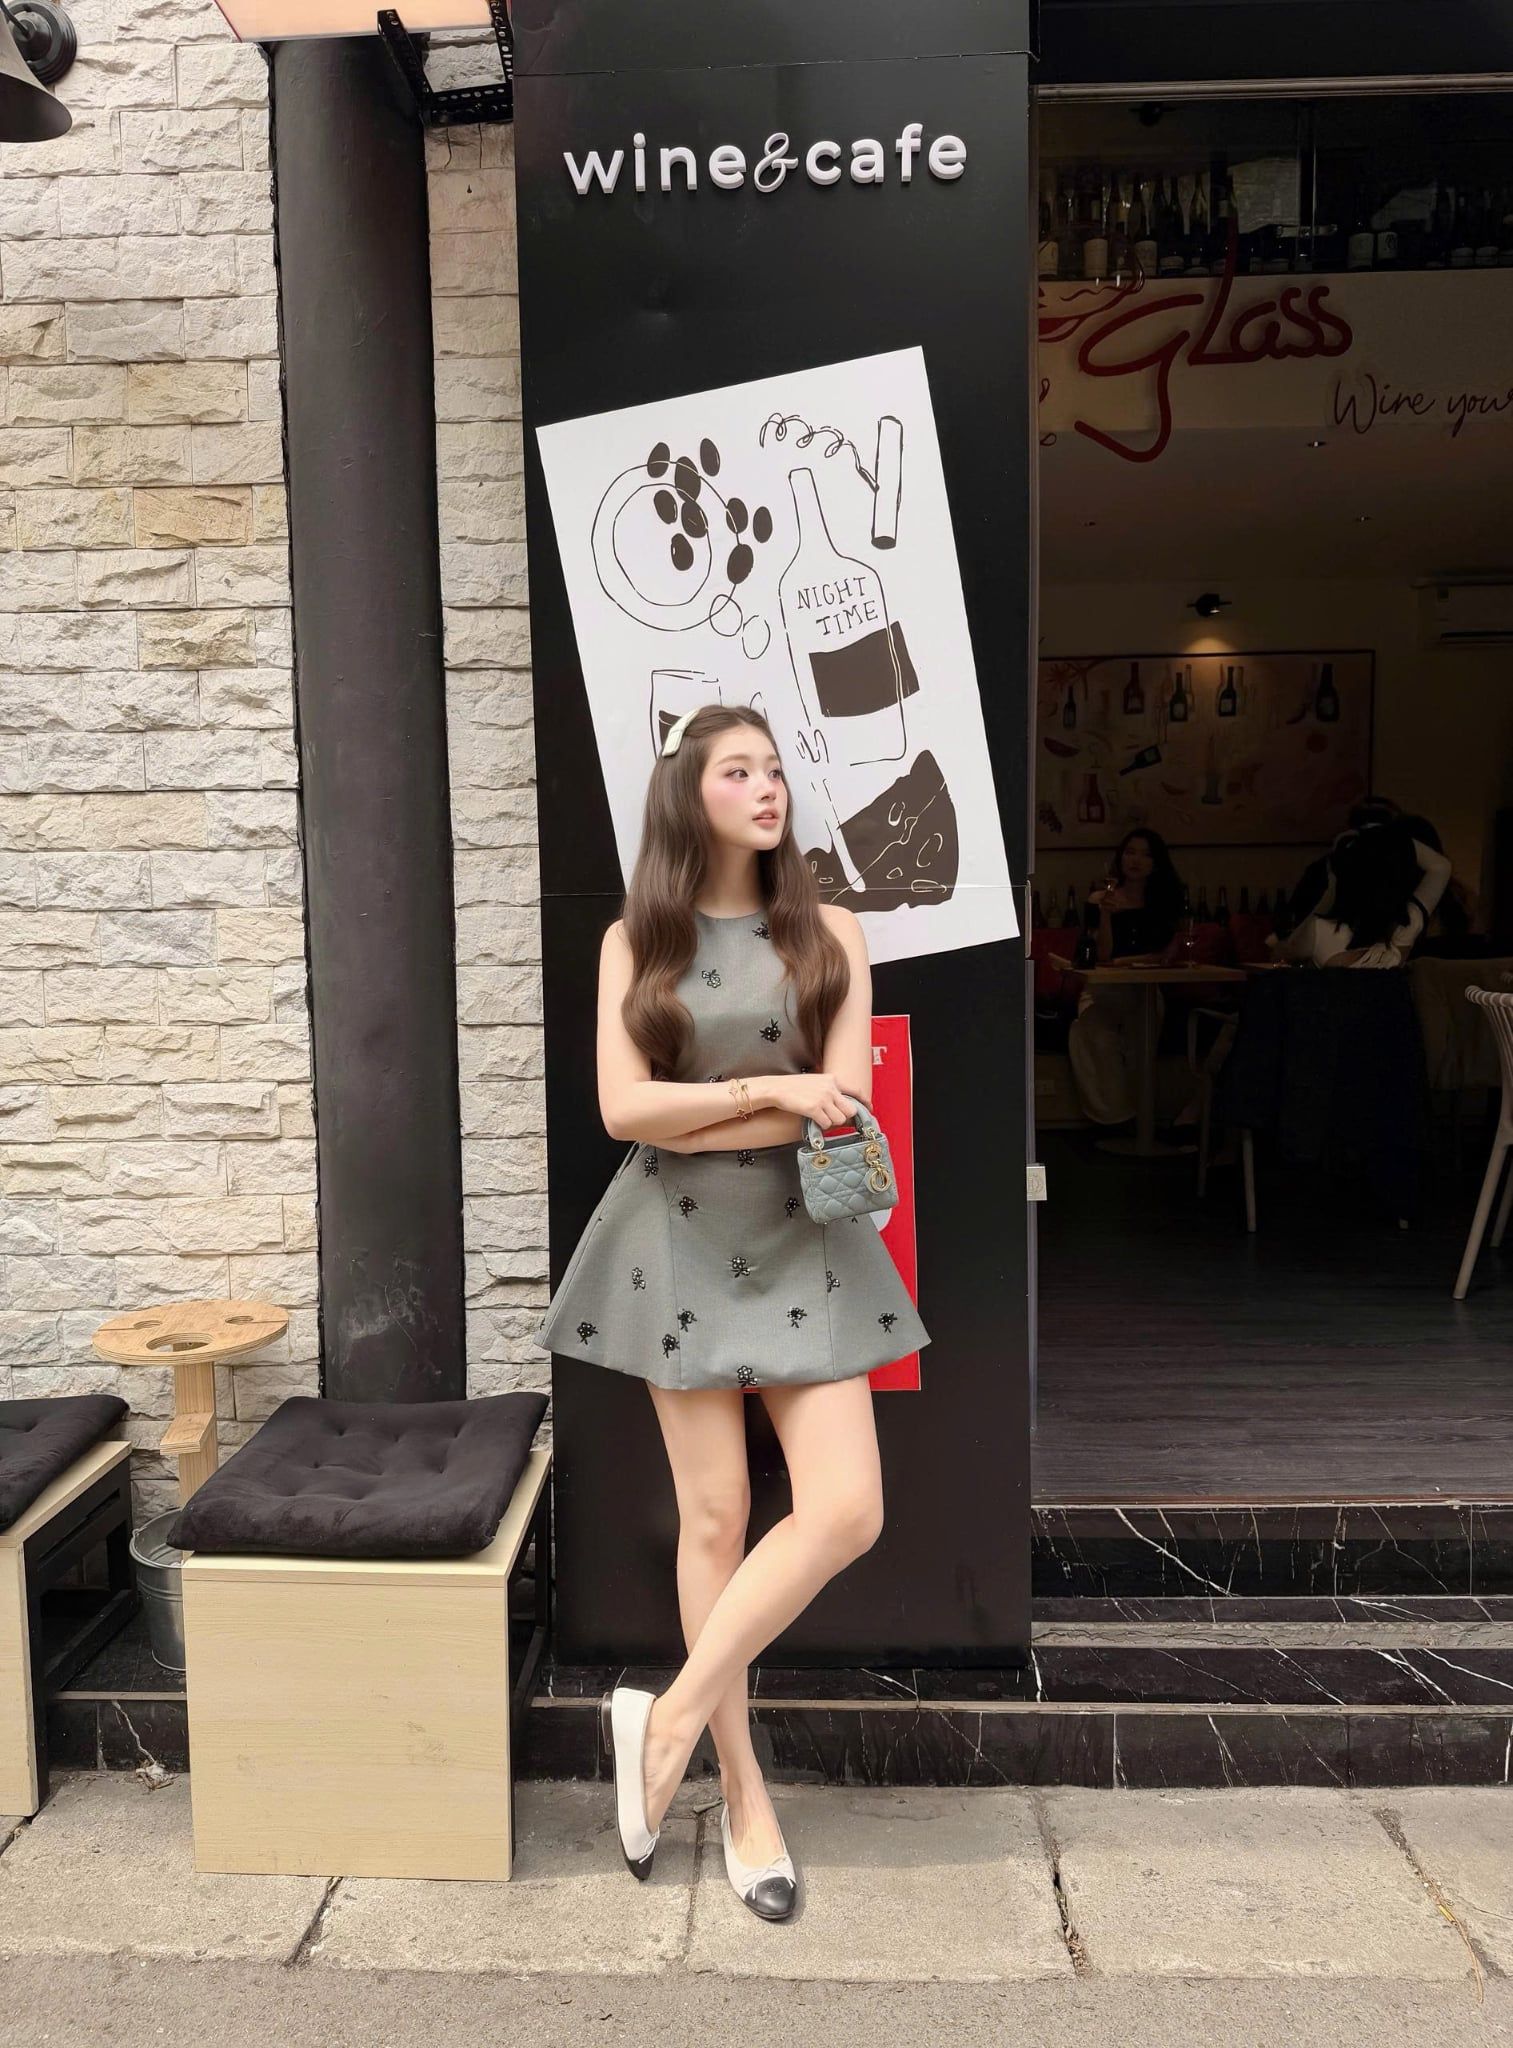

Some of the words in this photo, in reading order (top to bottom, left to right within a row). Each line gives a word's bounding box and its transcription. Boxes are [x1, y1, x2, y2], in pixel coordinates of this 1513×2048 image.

[563, 122, 968, 195] wine&cafe
[1334, 373, 1436, 435] Wine
[797, 576, 867, 610] NIGHT
[815, 599, 879, 636] TIME
